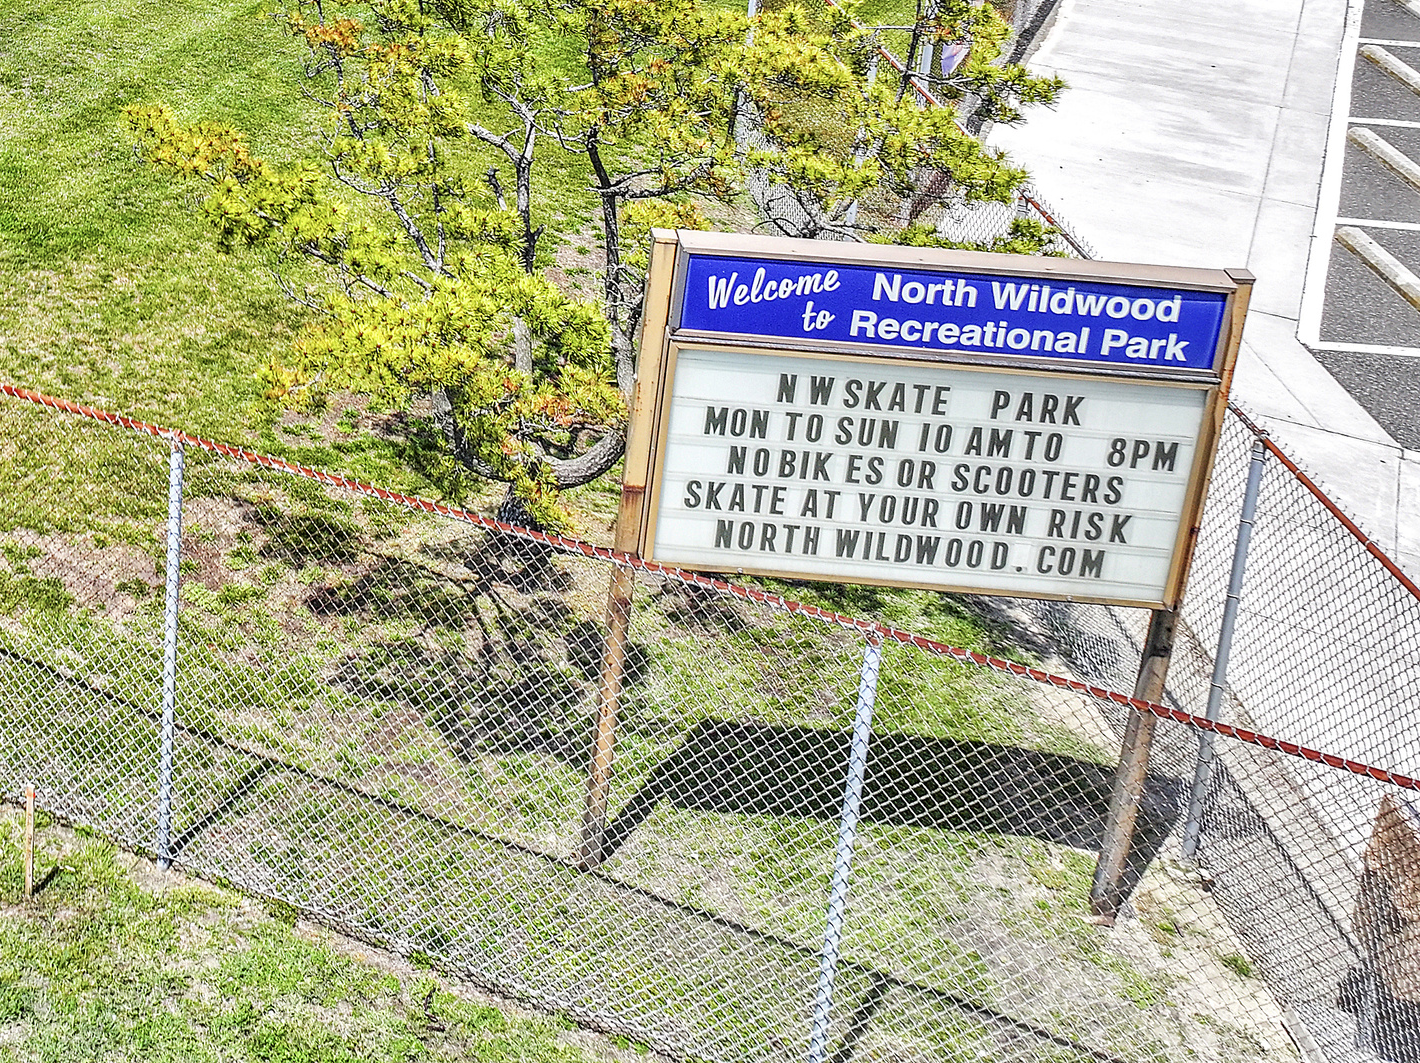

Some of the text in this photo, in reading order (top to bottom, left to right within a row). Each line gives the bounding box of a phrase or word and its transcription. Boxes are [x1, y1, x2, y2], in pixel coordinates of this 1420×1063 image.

[708, 267, 840, 309] Welcome
[872, 273, 1181, 323] North Wildwood
[802, 301, 835, 332] to
[850, 309, 1190, 362] Recreational Park
[990, 390, 1085, 426] PARK
[704, 406, 769, 439] MON
[785, 412, 824, 443] TO
[835, 416, 899, 449] SUN
[964, 427, 1014, 458] AM
[1024, 431, 1063, 462] TO
[1107, 438, 1179, 472] 8PM
[727, 445, 770, 477] NO
[897, 458, 936, 489] OR
[951, 463, 1124, 505] SCOOTERS
[684, 480, 1132, 544] SKATE AT YOUR OWN RISK
[714, 519, 820, 555] NORTH
